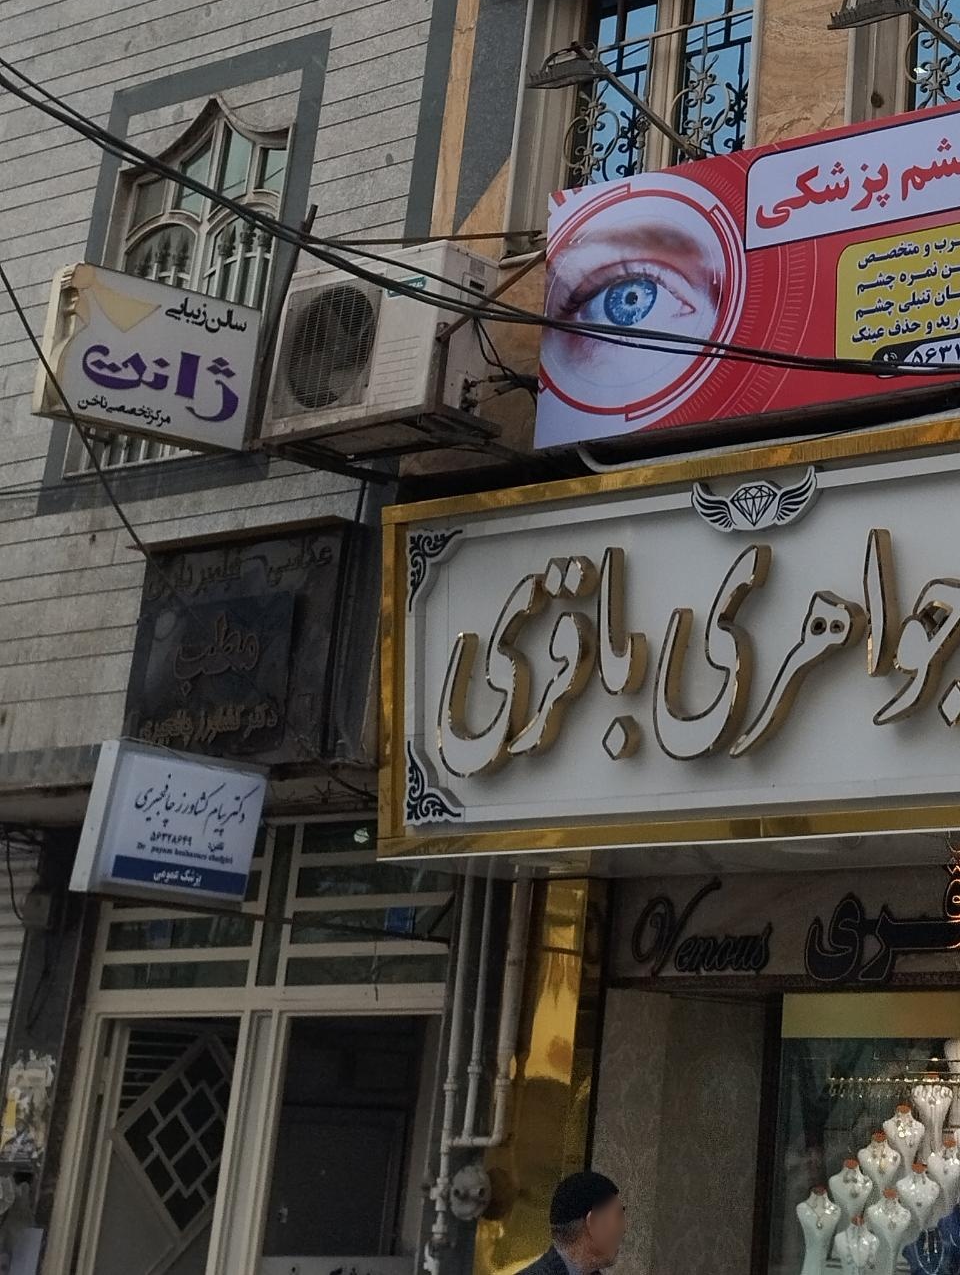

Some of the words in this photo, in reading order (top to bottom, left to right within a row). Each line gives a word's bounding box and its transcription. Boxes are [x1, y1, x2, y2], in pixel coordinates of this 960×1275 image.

[755, 161, 890, 229] پزشکی
[857, 243, 920, 269] متخصص
[923, 244, 931, 257] و
[857, 274, 895, 295] چشم
[899, 262, 938, 286] نمره
[165, 297, 207, 325] زیبایی
[855, 298, 895, 321] چشم
[898, 290, 931, 313] تنبلی
[204, 309, 248, 333] سالن
[888, 319, 921, 338] حذف
[926, 321, 932, 335] و
[852, 326, 884, 344] عینک
[82, 344, 239, 422] ژانت
[77, 395, 107, 410] ناخن
[106, 401, 150, 419] تخصصی
[145, 406, 171, 427] مرکز
[437, 545, 648, 778] باقری
[220, 785, 259, 825] دکتر
